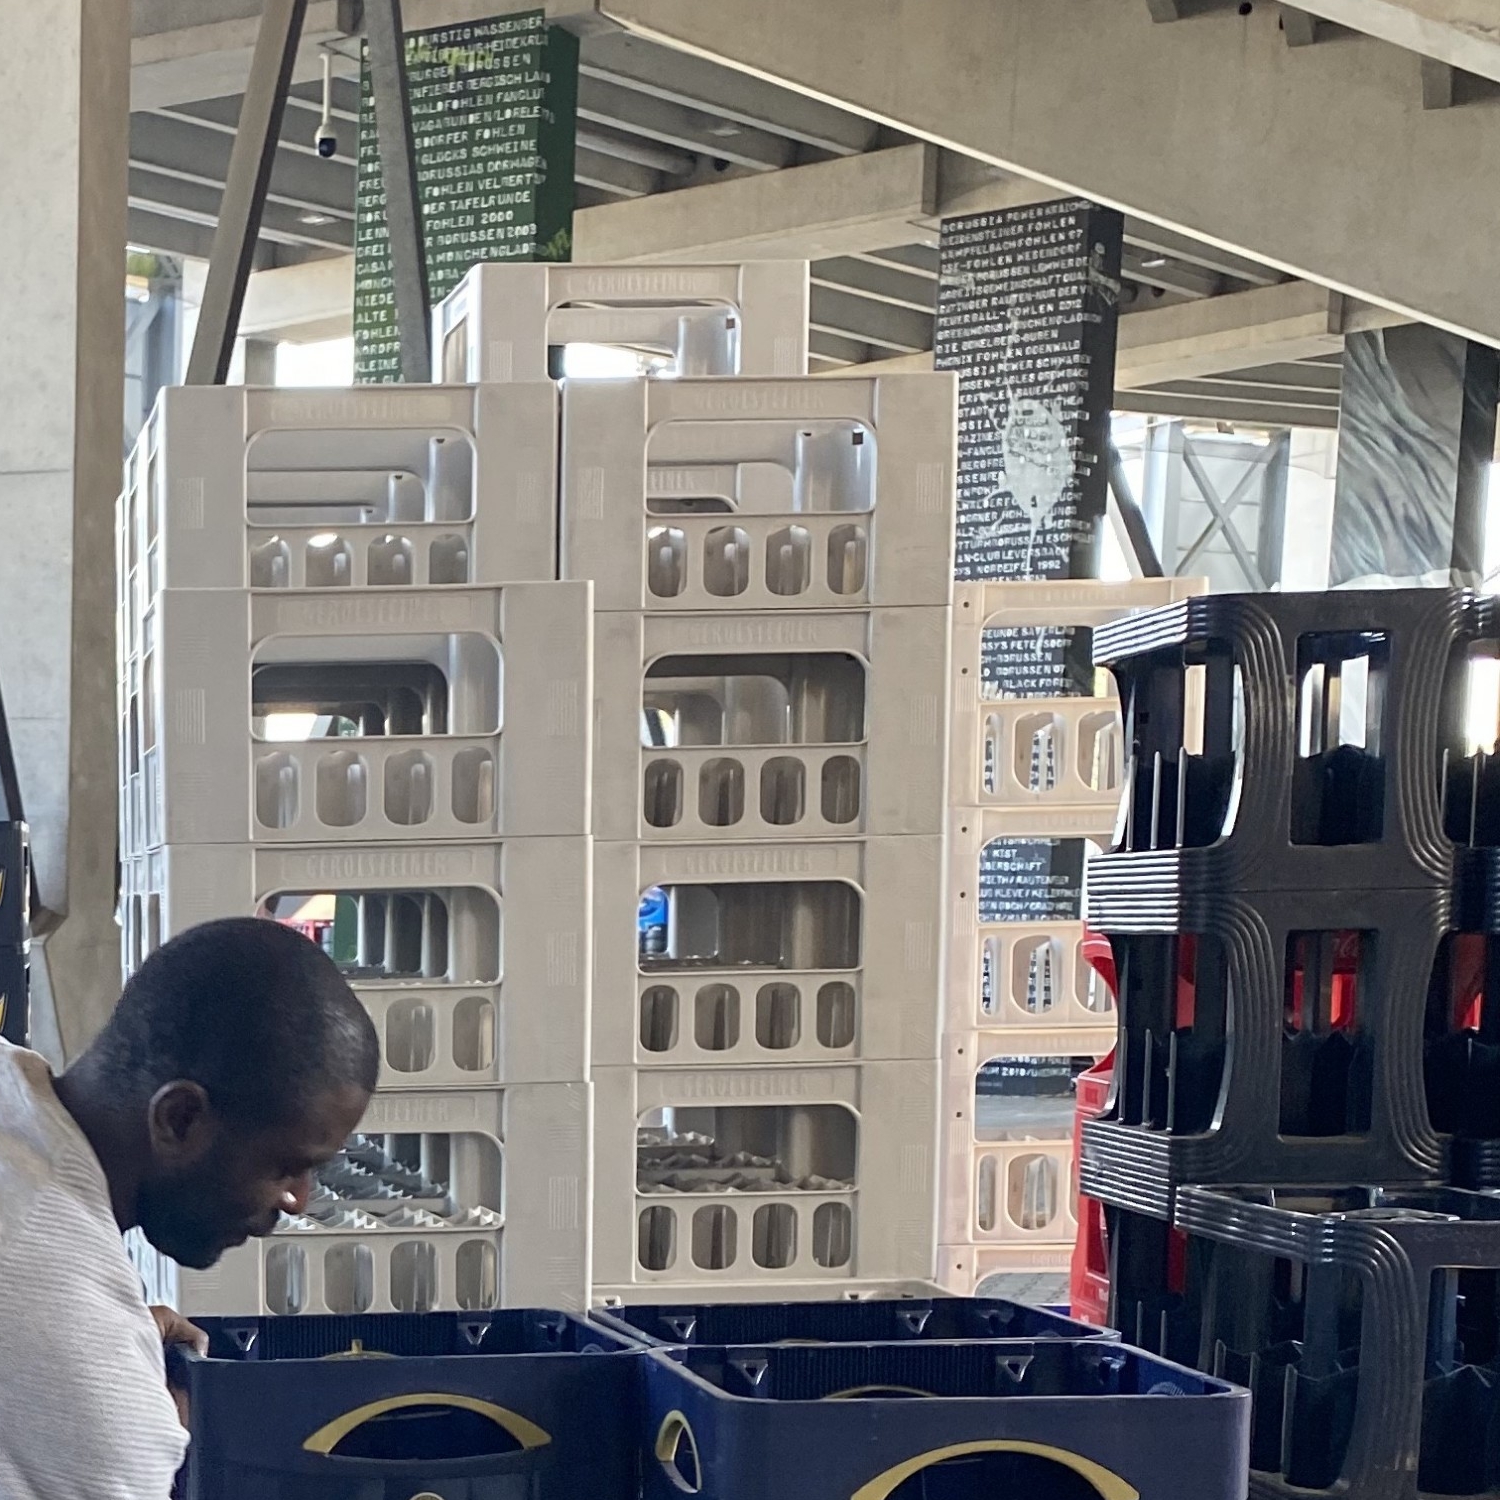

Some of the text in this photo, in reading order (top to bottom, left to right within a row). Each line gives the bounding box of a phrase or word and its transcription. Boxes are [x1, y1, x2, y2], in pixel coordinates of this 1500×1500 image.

[475, 124, 525, 140] FOHLEN
[471, 139, 537, 158] SCHWEINE
[425, 181, 474, 199] FOHLEN
[422, 201, 447, 216] DER
[449, 190, 531, 212] TAFELRUNDE
[426, 214, 475, 231] FOHLEN
[480, 210, 514, 225] 2000
[941, 215, 1003, 235] BORUSSIA
[1027, 215, 1076, 233] FOHLEN
[436, 228, 505, 248] BORUSSEN
[356, 310, 387, 323] ALTE
[1037, 560, 1061, 570] 1992
[306, 850, 448, 879] GEROLSTEINER
